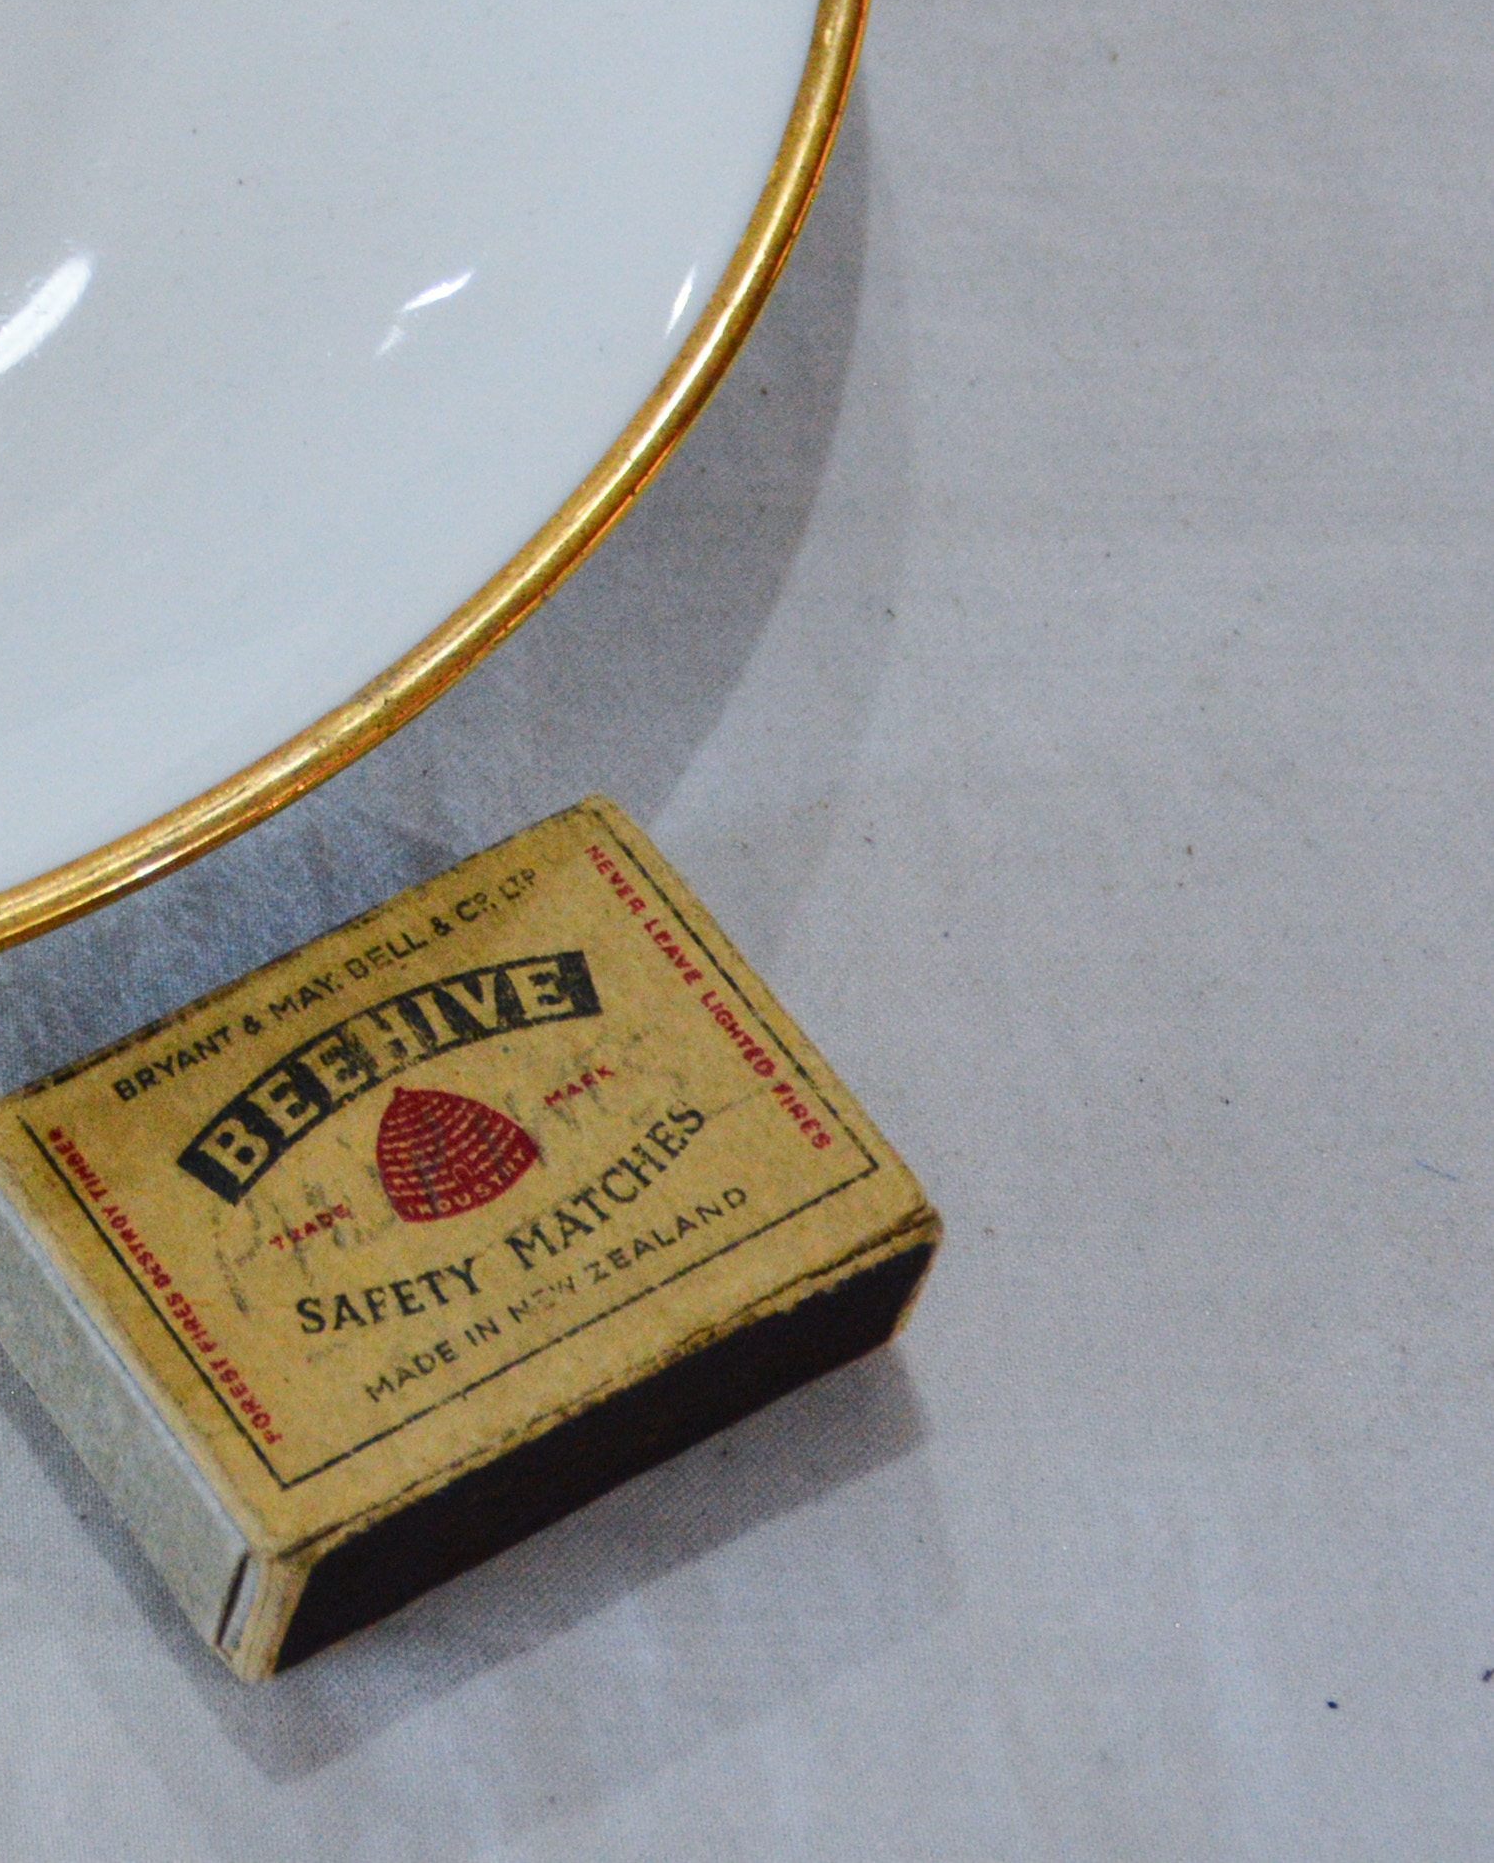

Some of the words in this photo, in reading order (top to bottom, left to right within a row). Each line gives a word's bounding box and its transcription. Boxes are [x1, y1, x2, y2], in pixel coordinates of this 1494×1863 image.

[113, 1026, 231, 1101] BRYANT
[242, 1014, 263, 1036] &
[431, 916, 454, 936] &
[197, 959, 577, 1185] BEEHIVE
[584, 844, 646, 915] NEVER
[643, 918, 704, 985] LEAVE
[700, 990, 776, 1078] LIGHTED
[771, 1083, 833, 1150] FIRES
[48, 1126, 108, 1202] TIMBER
[101, 1205, 172, 1290] DESTROY
[268, 1203, 353, 1251] TRADE
[544, 1065, 615, 1107] MARK
[296, 1257, 482, 1334] SAFETY
[504, 1108, 705, 1270] MATCHES
[165, 1292, 217, 1354] FIRES
[365, 1340, 458, 1403] MADE
[464, 1318, 501, 1346] IN
[584, 1187, 748, 1285] ZEALAND
[209, 1358, 284, 1445] FOREST
